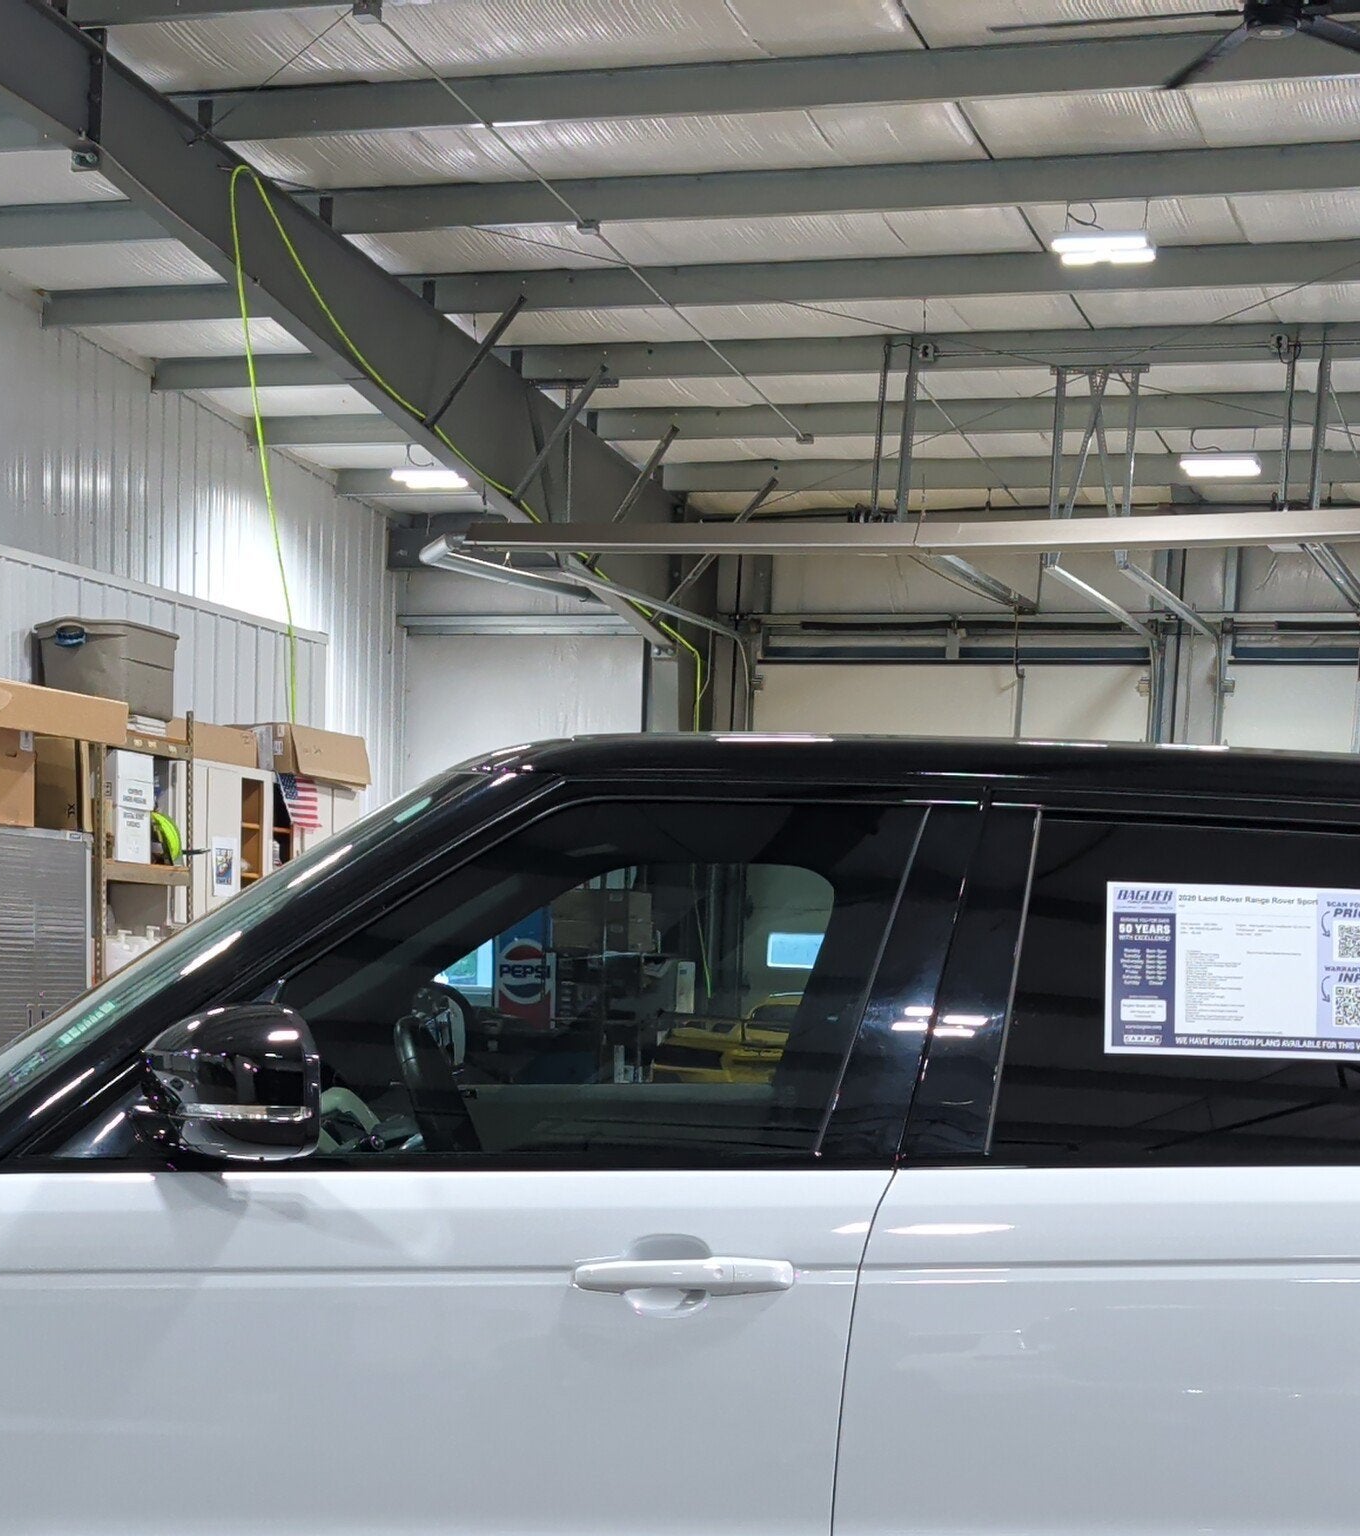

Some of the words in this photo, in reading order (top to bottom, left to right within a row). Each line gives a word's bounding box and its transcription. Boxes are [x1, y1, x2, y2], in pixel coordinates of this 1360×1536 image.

[1198, 894, 1218, 902] Land
[1220, 895, 1243, 903] Rover
[1244, 896, 1270, 905] Range
[1271, 897, 1295, 905] Rover
[1297, 898, 1319, 906] Sport
[1119, 923, 1133, 934] 50
[1135, 924, 1171, 935] YEARS
[500, 964, 551, 979] PEPSI
[1175, 1036, 1188, 1045] WE
[1189, 1037, 1208, 1045] HAVE
[1209, 1037, 1255, 1047] PROTECTION
[1255, 1038, 1280, 1047] PLANS
[1281, 1039, 1321, 1049] AVAILABLE
[1322, 1040, 1337, 1049] FOR
[1338, 1041, 1355, 1050] THIS
